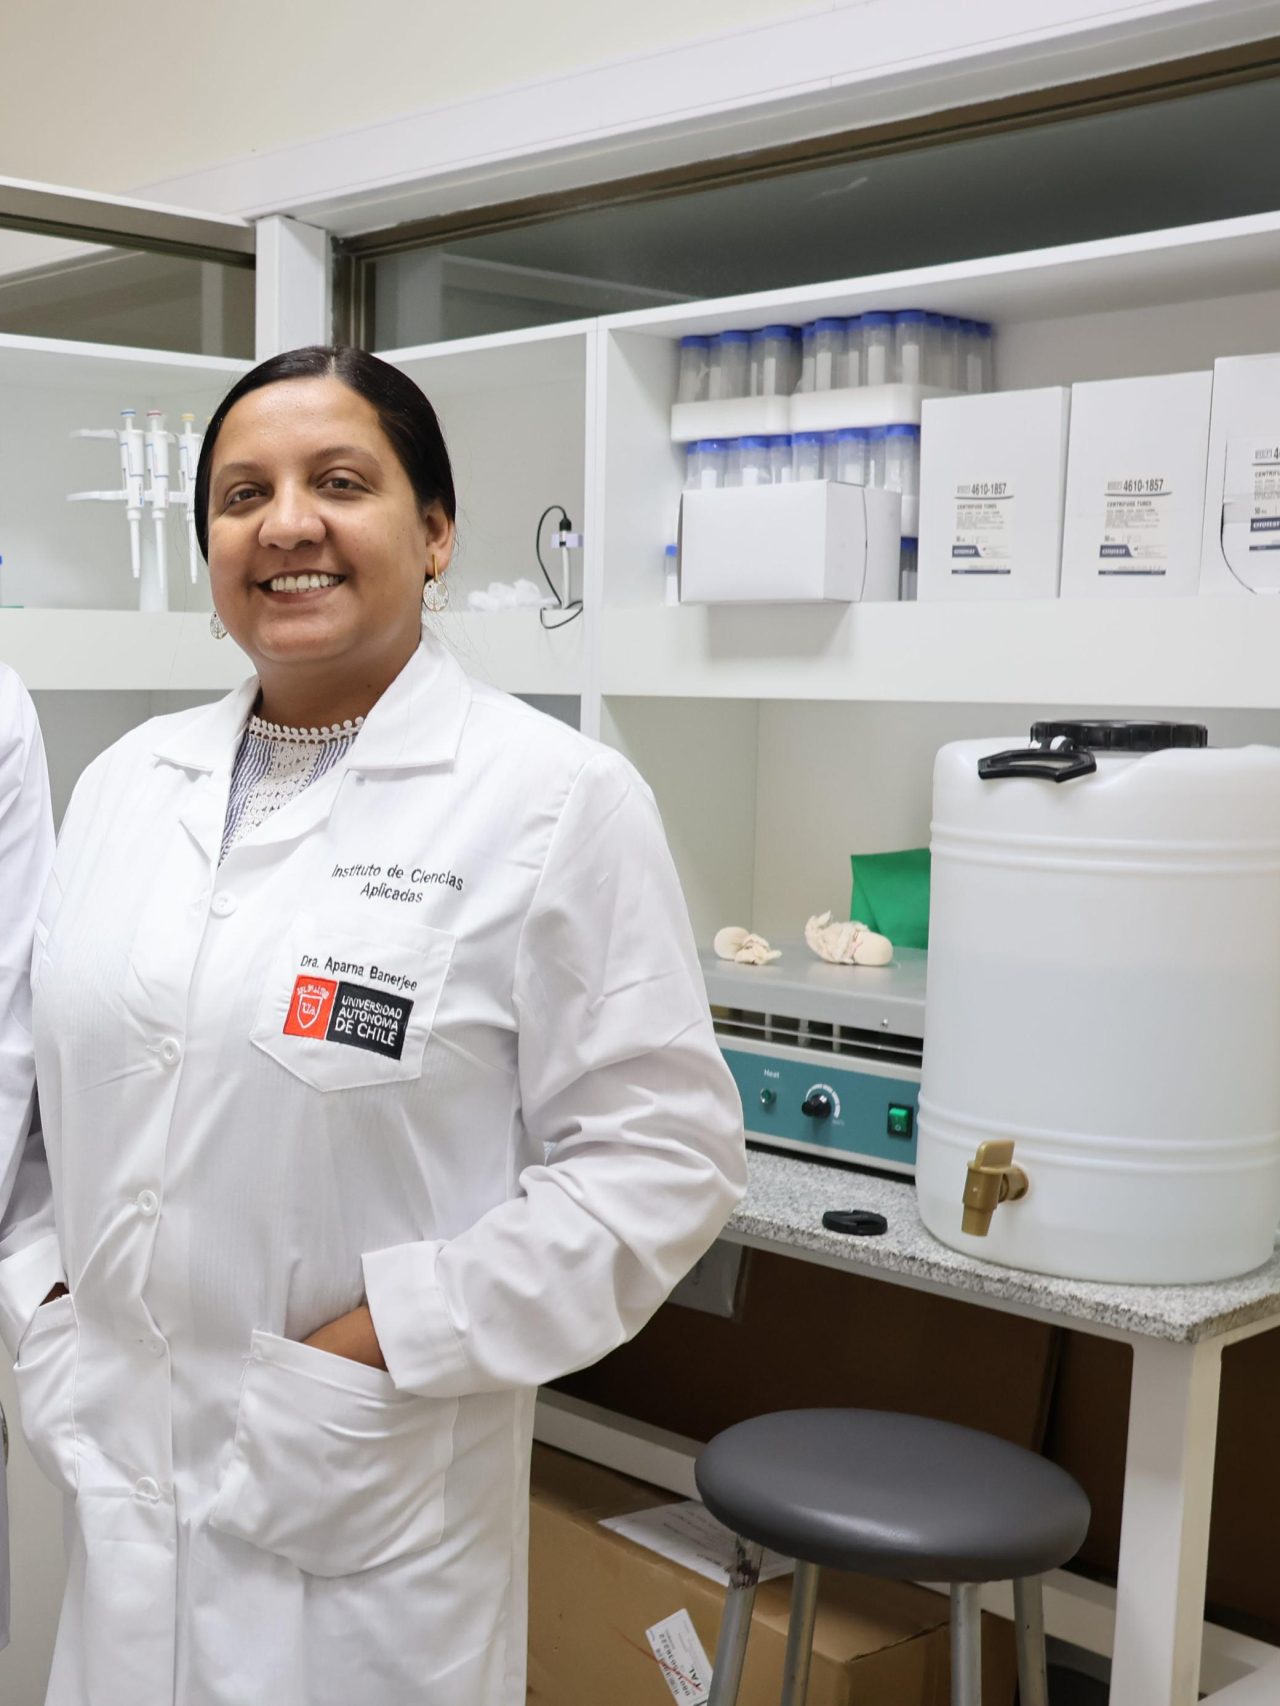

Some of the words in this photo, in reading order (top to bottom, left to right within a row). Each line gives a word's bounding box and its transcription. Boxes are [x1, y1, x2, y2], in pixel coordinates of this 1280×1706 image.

[971, 482, 1007, 496] 4610-1857
[1123, 478, 1164, 492] 4610-1857
[331, 864, 382, 878] Instituto
[387, 865, 404, 879] de
[410, 868, 464, 891] Ciencias
[360, 882, 423, 903] Aplicadas
[300, 955, 320, 968] Dra.
[324, 956, 364, 975] Aparna
[369, 965, 417, 991] Banerjee
[341, 995, 402, 1019] UNIVERSIDAD
[335, 1017, 354, 1034] DE
[357, 1023, 397, 1046] CHILE
[764, 1068, 780, 1079] Heat
